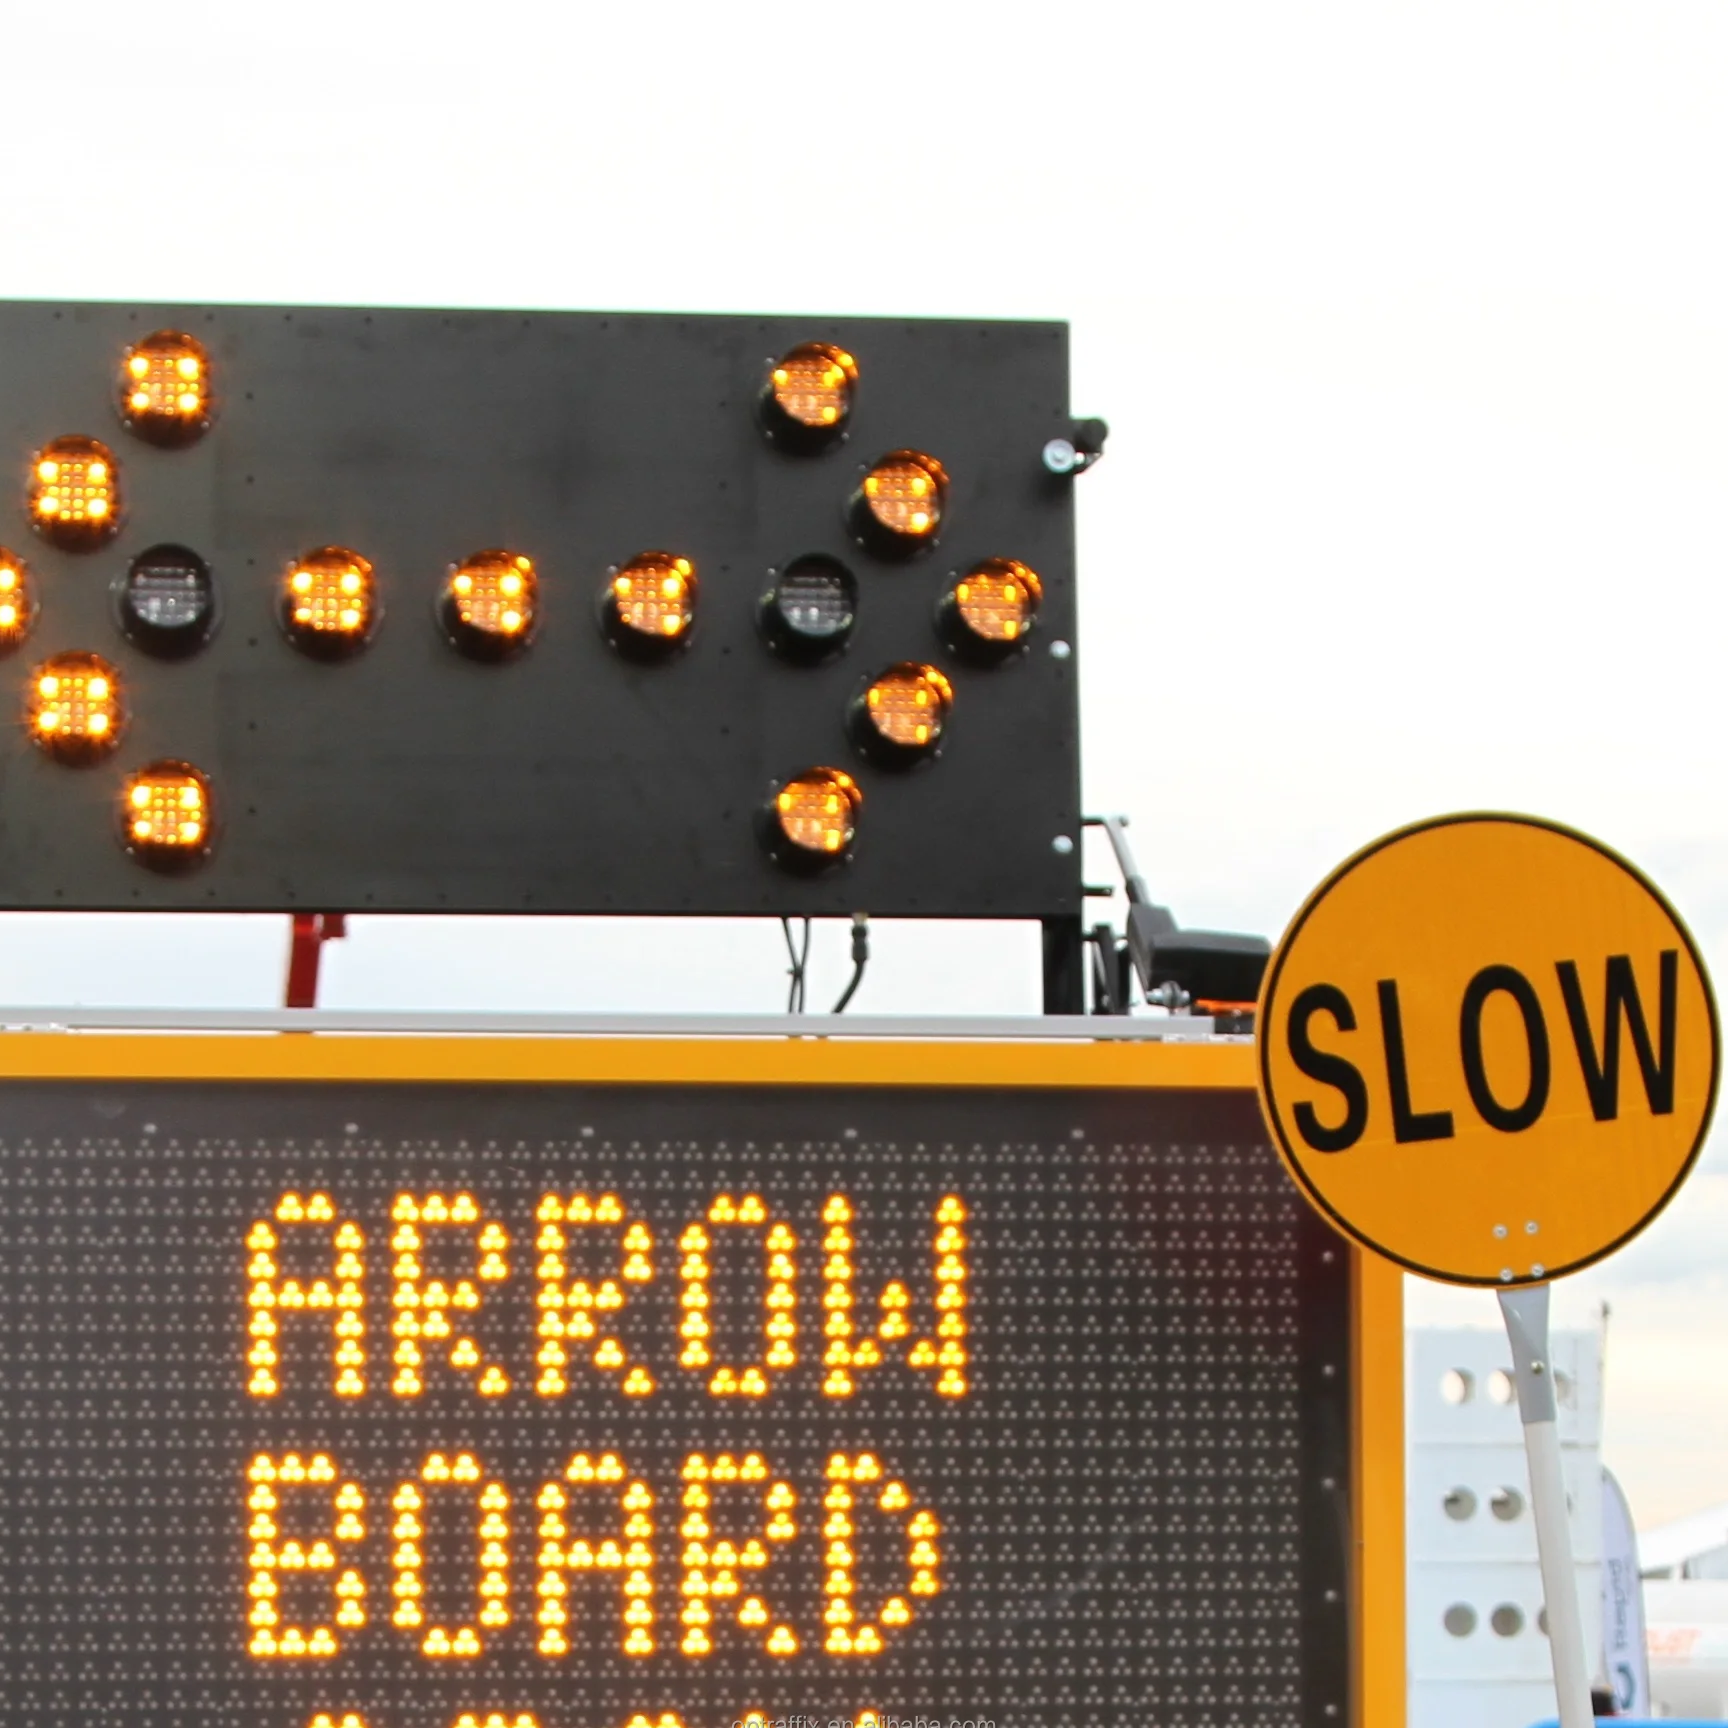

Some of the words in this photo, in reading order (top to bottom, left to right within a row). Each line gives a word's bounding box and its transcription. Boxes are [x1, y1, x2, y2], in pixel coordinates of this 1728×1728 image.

[1287, 950, 1679, 1153] SLOW
[246, 1192, 970, 1398] ARROW
[246, 1451, 940, 1657] BOARD
